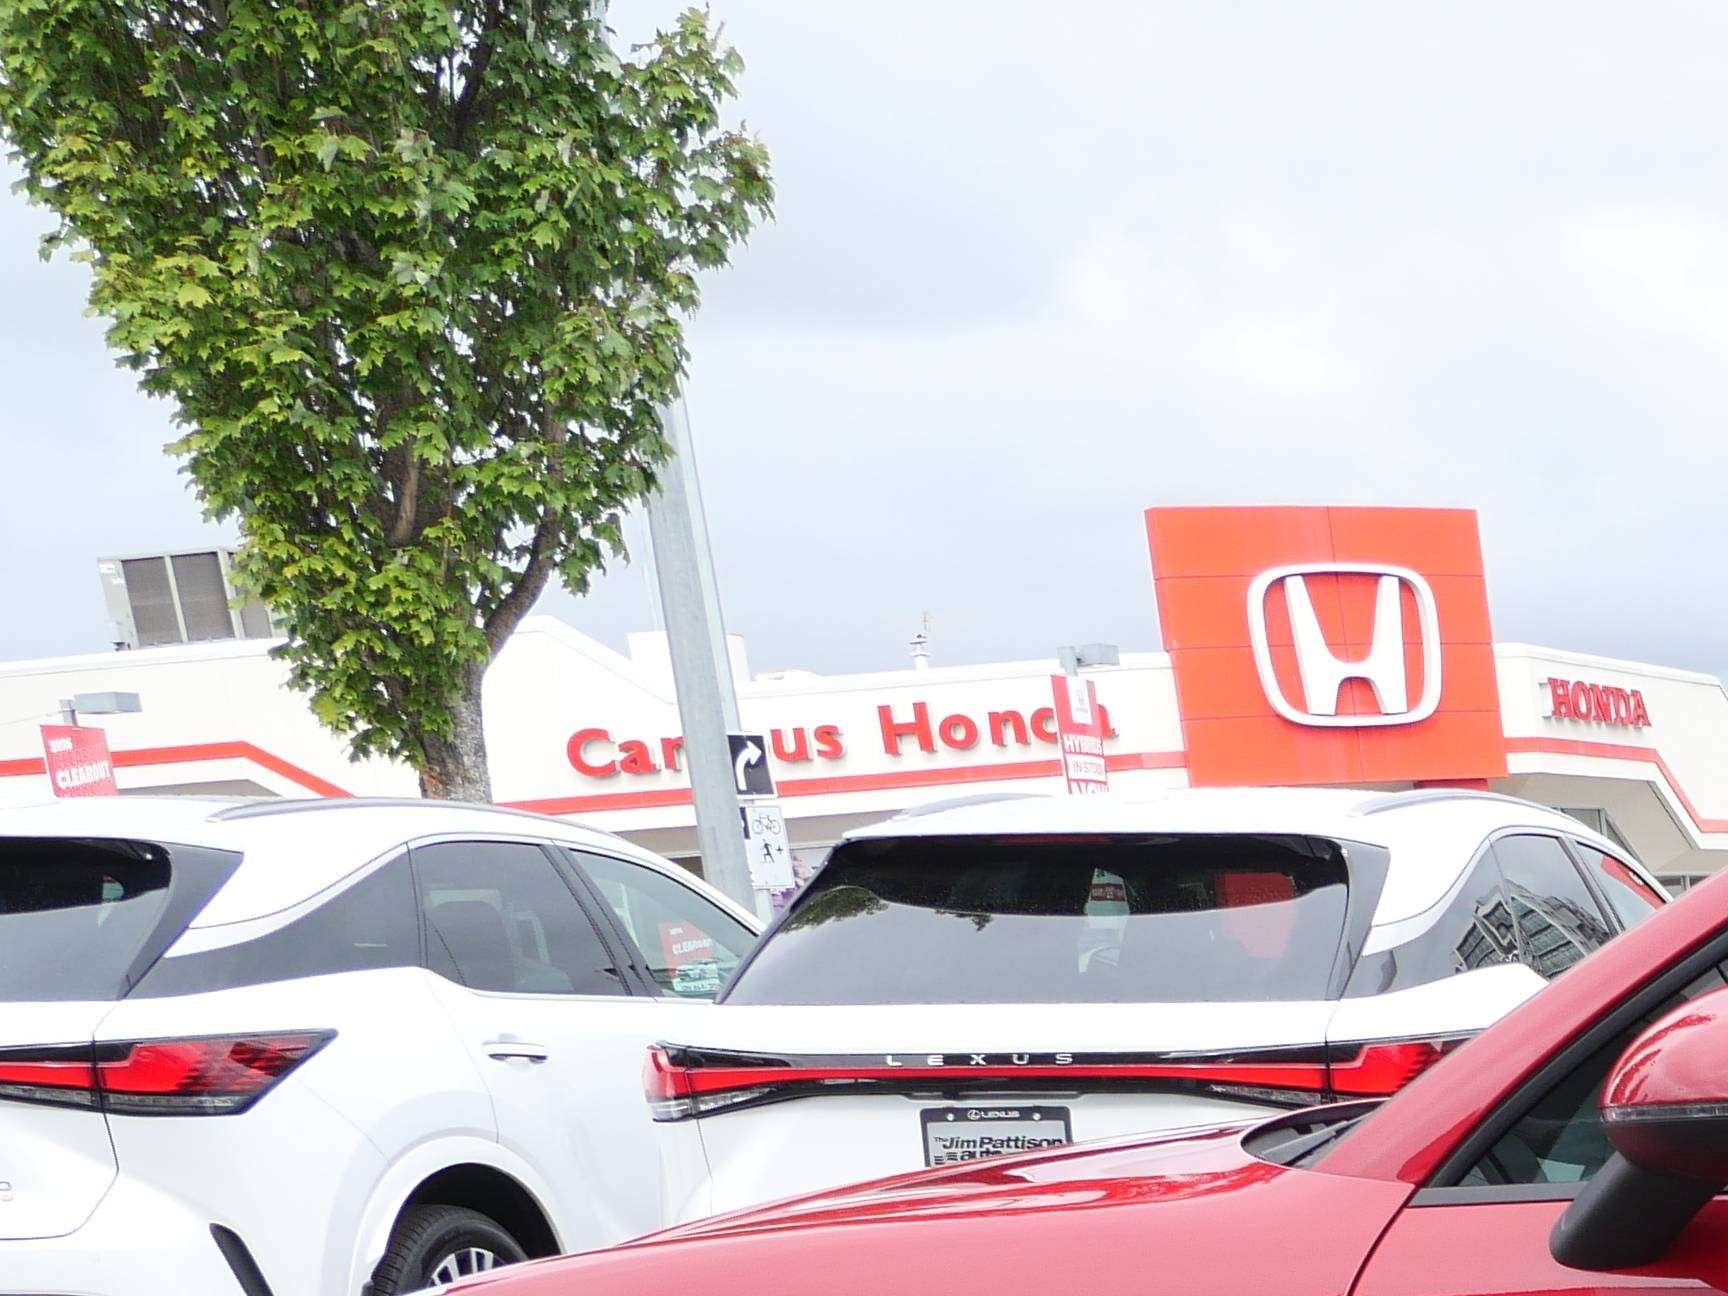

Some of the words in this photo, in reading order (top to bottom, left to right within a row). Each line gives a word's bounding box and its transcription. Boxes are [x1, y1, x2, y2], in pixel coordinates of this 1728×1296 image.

[1546, 676, 1652, 729] HONDA
[566, 717, 844, 778] Caus
[886, 1053, 1074, 1066] LEXUS
[942, 1135, 977, 1150] Jim
[979, 1135, 1063, 1150] Pattison
